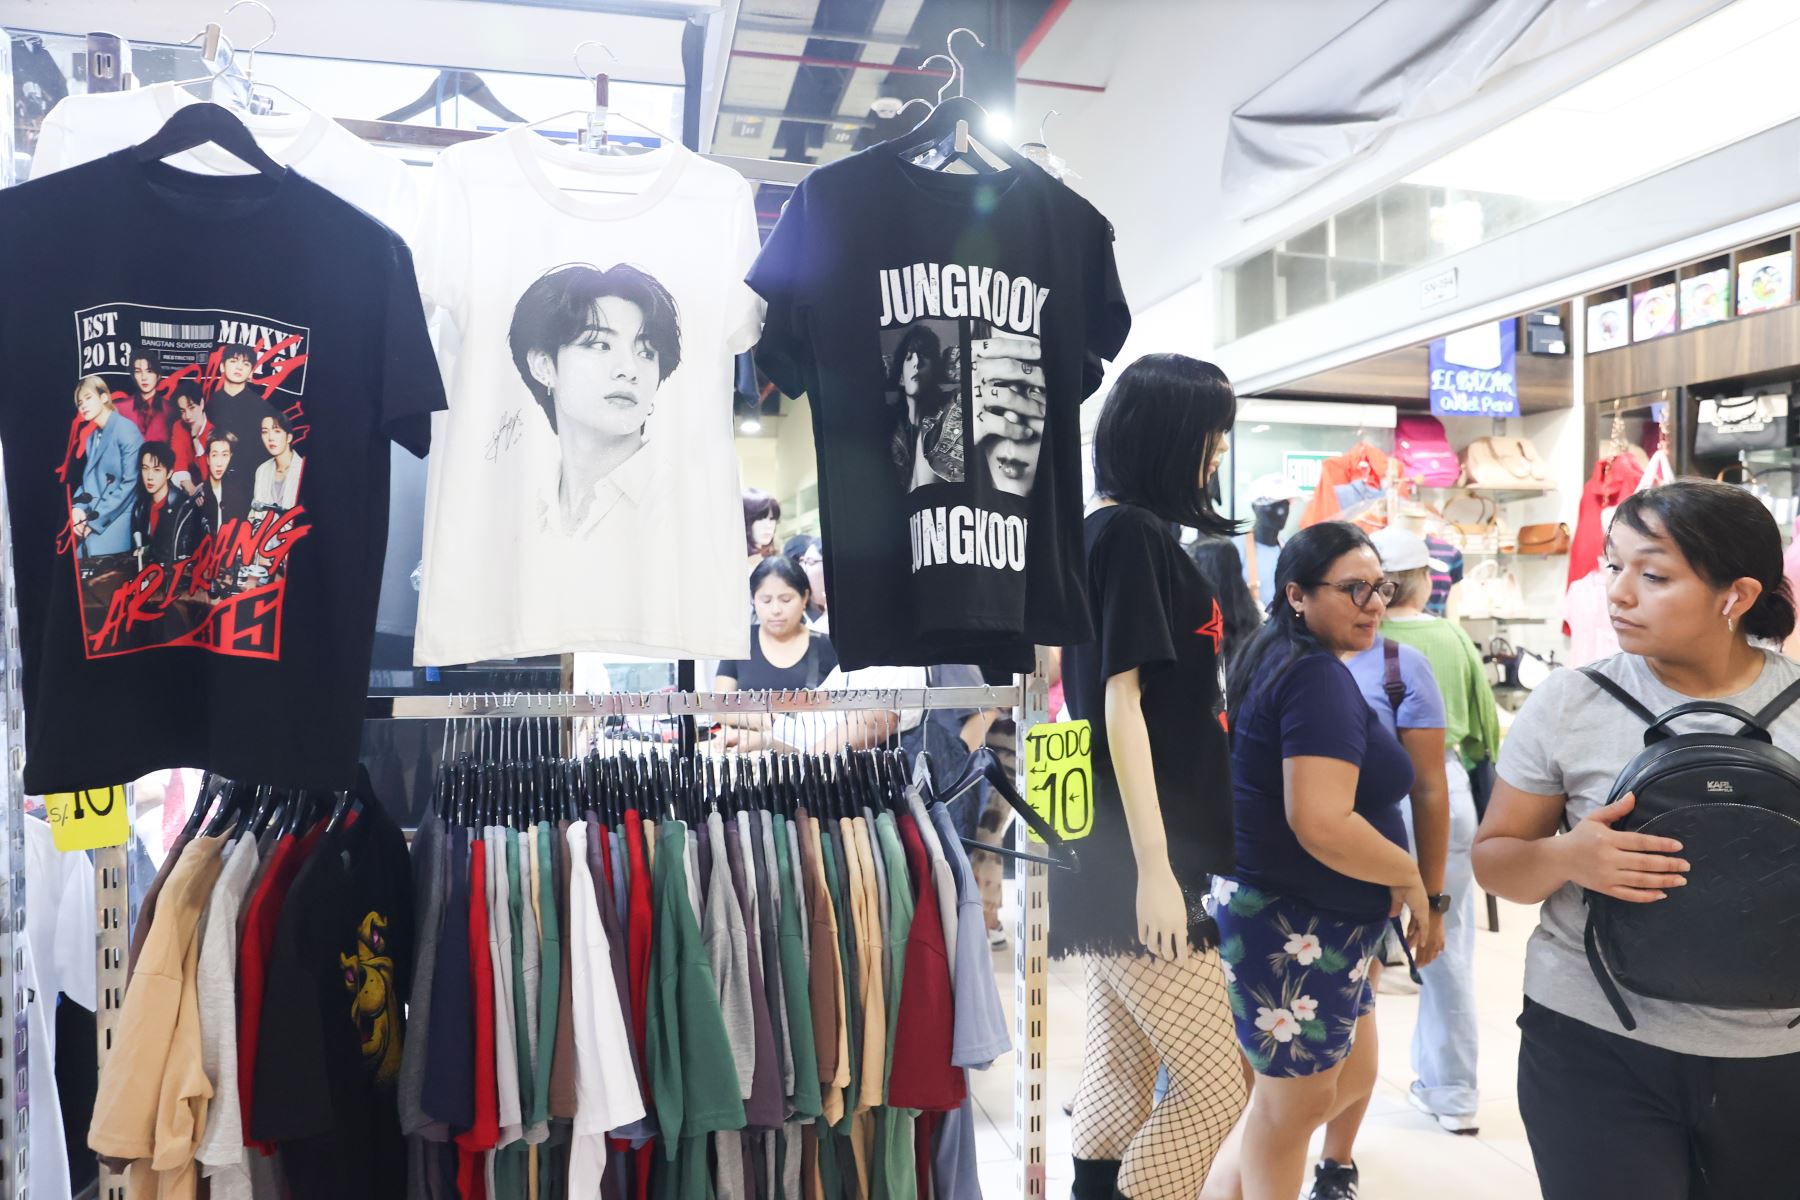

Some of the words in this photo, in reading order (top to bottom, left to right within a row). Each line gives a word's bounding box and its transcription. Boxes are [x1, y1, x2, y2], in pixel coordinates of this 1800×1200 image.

[83, 311, 119, 341] EST
[83, 342, 132, 369] 2013
[141, 338, 175, 348] BANGTAN
[88, 504, 313, 653] ARIRANG
[1026, 726, 1091, 762] TODO
[1706, 780, 1733, 789] KARL
[1040, 768, 1089, 834] 10
